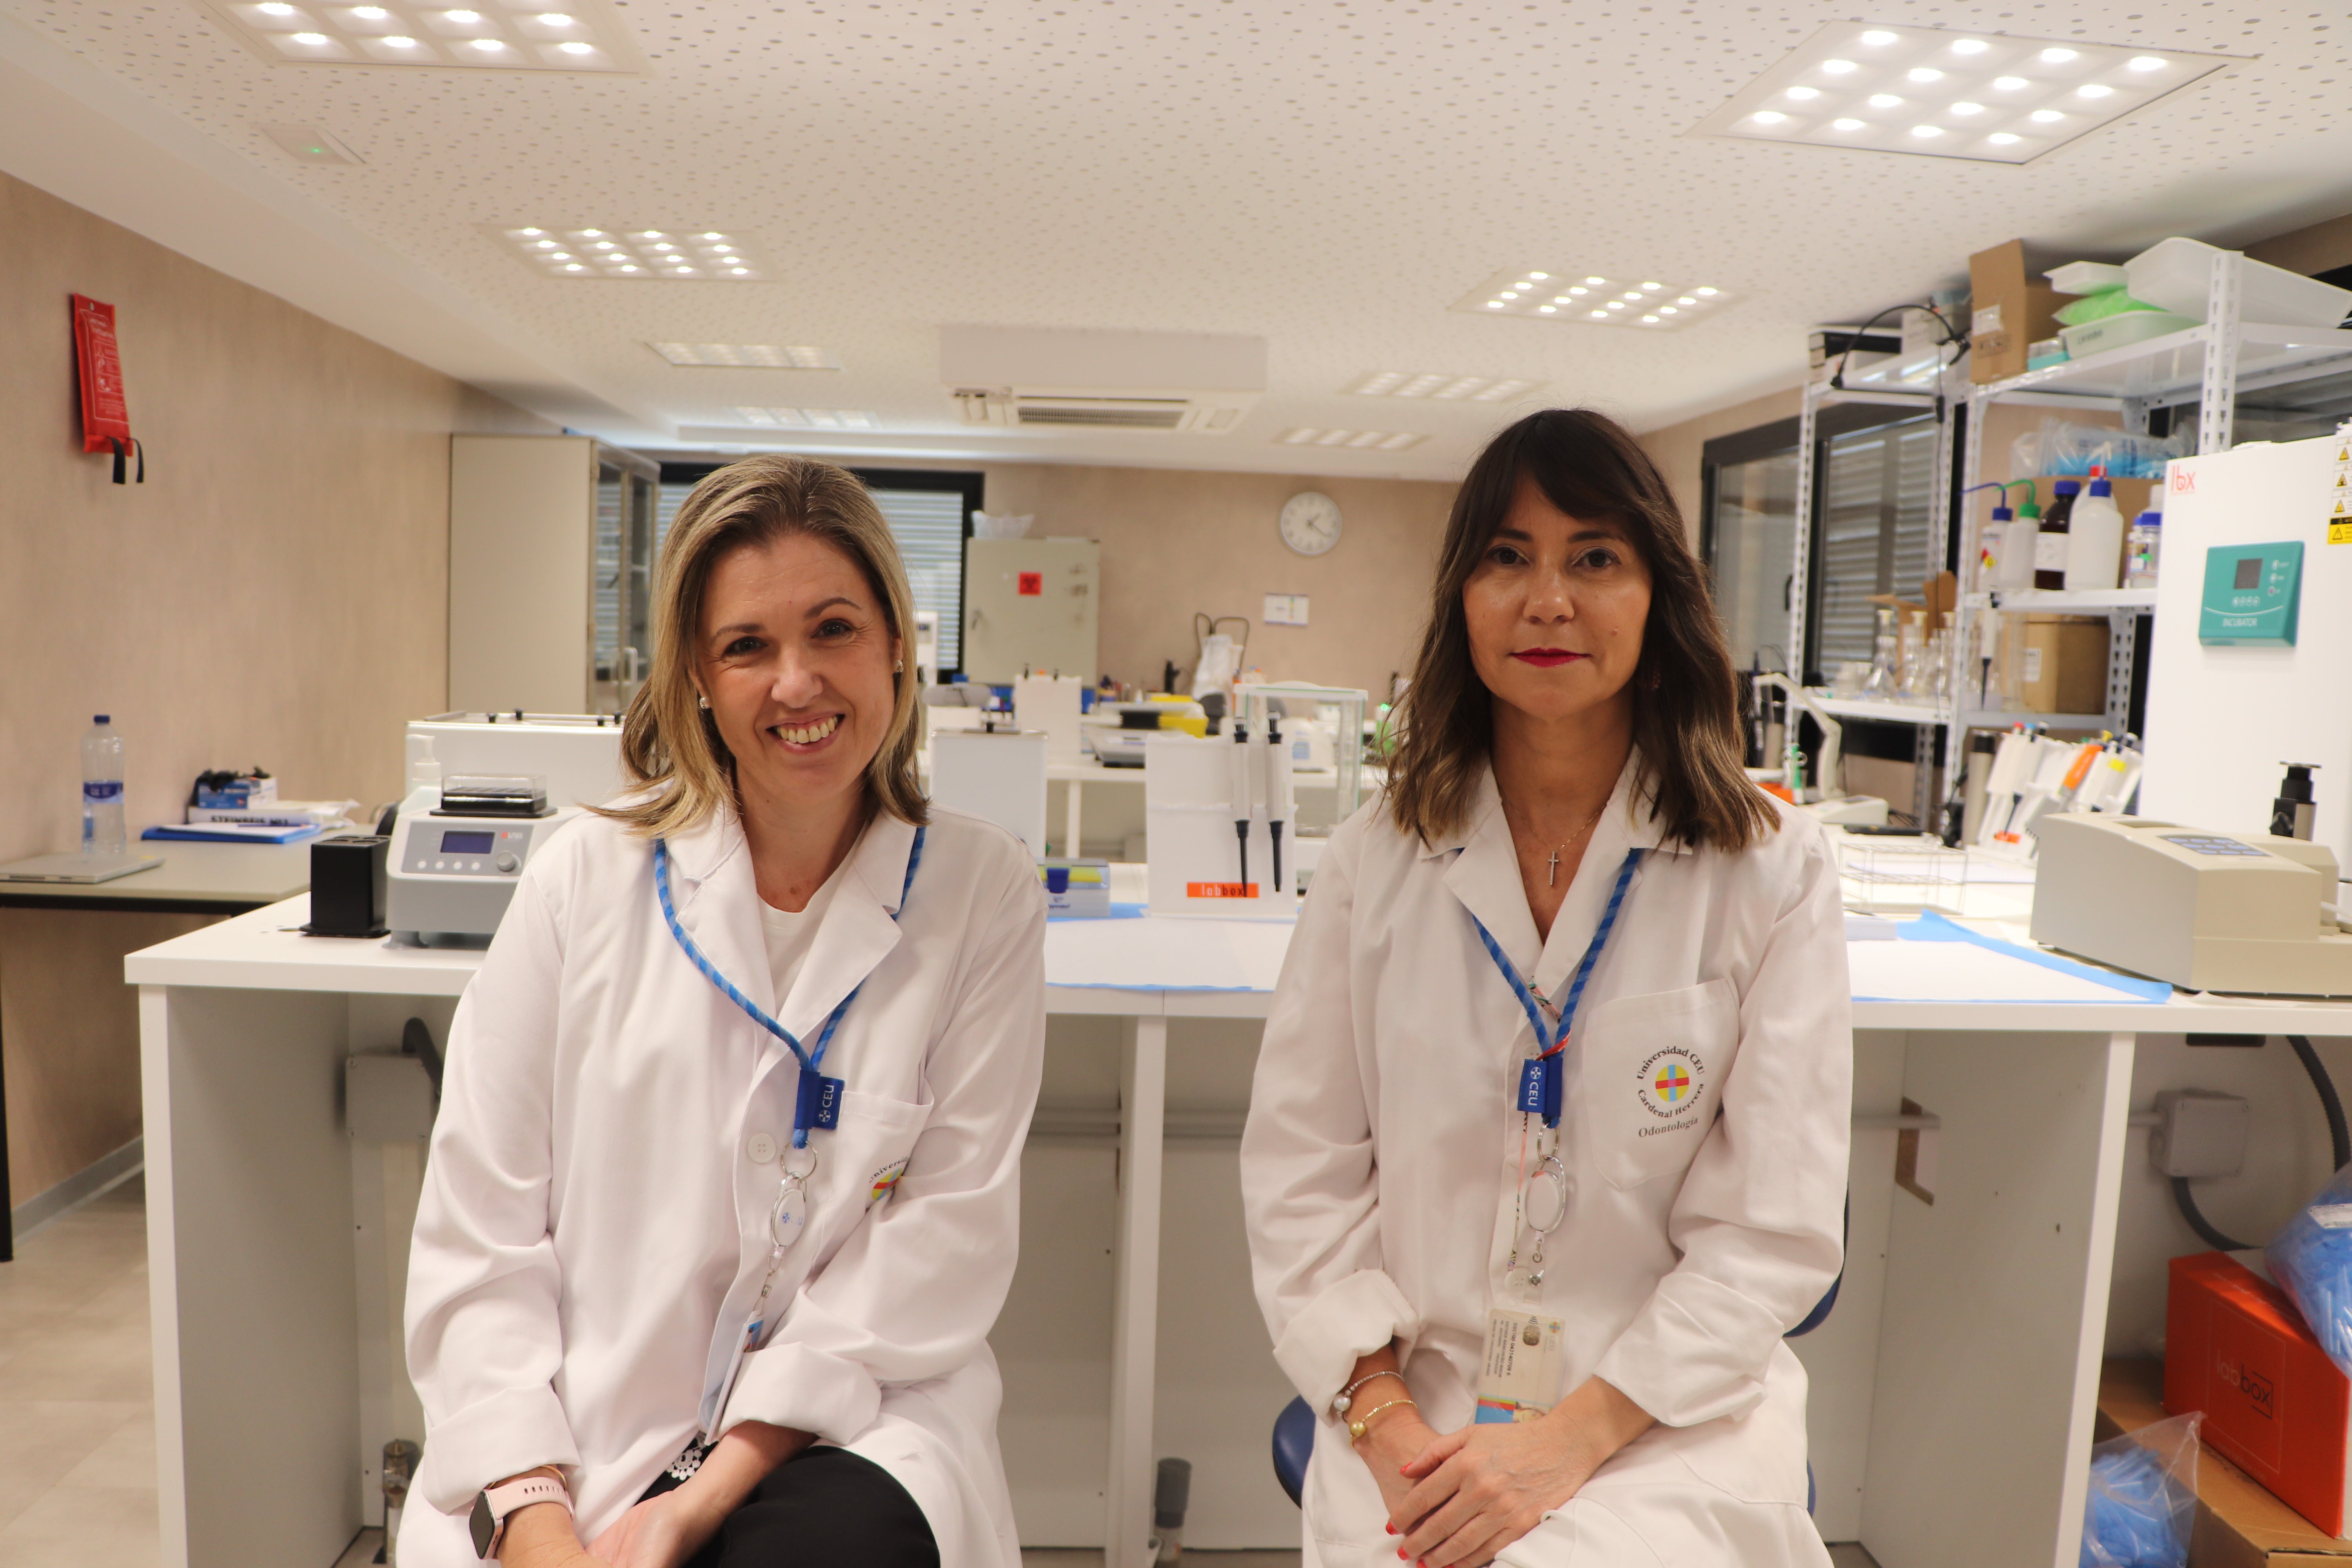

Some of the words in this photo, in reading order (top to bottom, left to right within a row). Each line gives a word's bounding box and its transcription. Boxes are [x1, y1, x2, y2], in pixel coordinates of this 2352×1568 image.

[2223, 618, 2258, 626] INCUBATOR
[1201, 884, 1244, 896] labbox
[1637, 1046, 1689, 1080] Universidad
[1690, 1053, 1705, 1074] CEU
[822, 1085, 835, 1107] CEU
[1528, 1082, 1539, 1106] CEU
[1638, 1089, 1672, 1118] Cardenal
[1675, 1083, 1704, 1116] Herrera
[1639, 1117, 1698, 1137] Odontología
[2217, 1348, 2270, 1408] labbox
